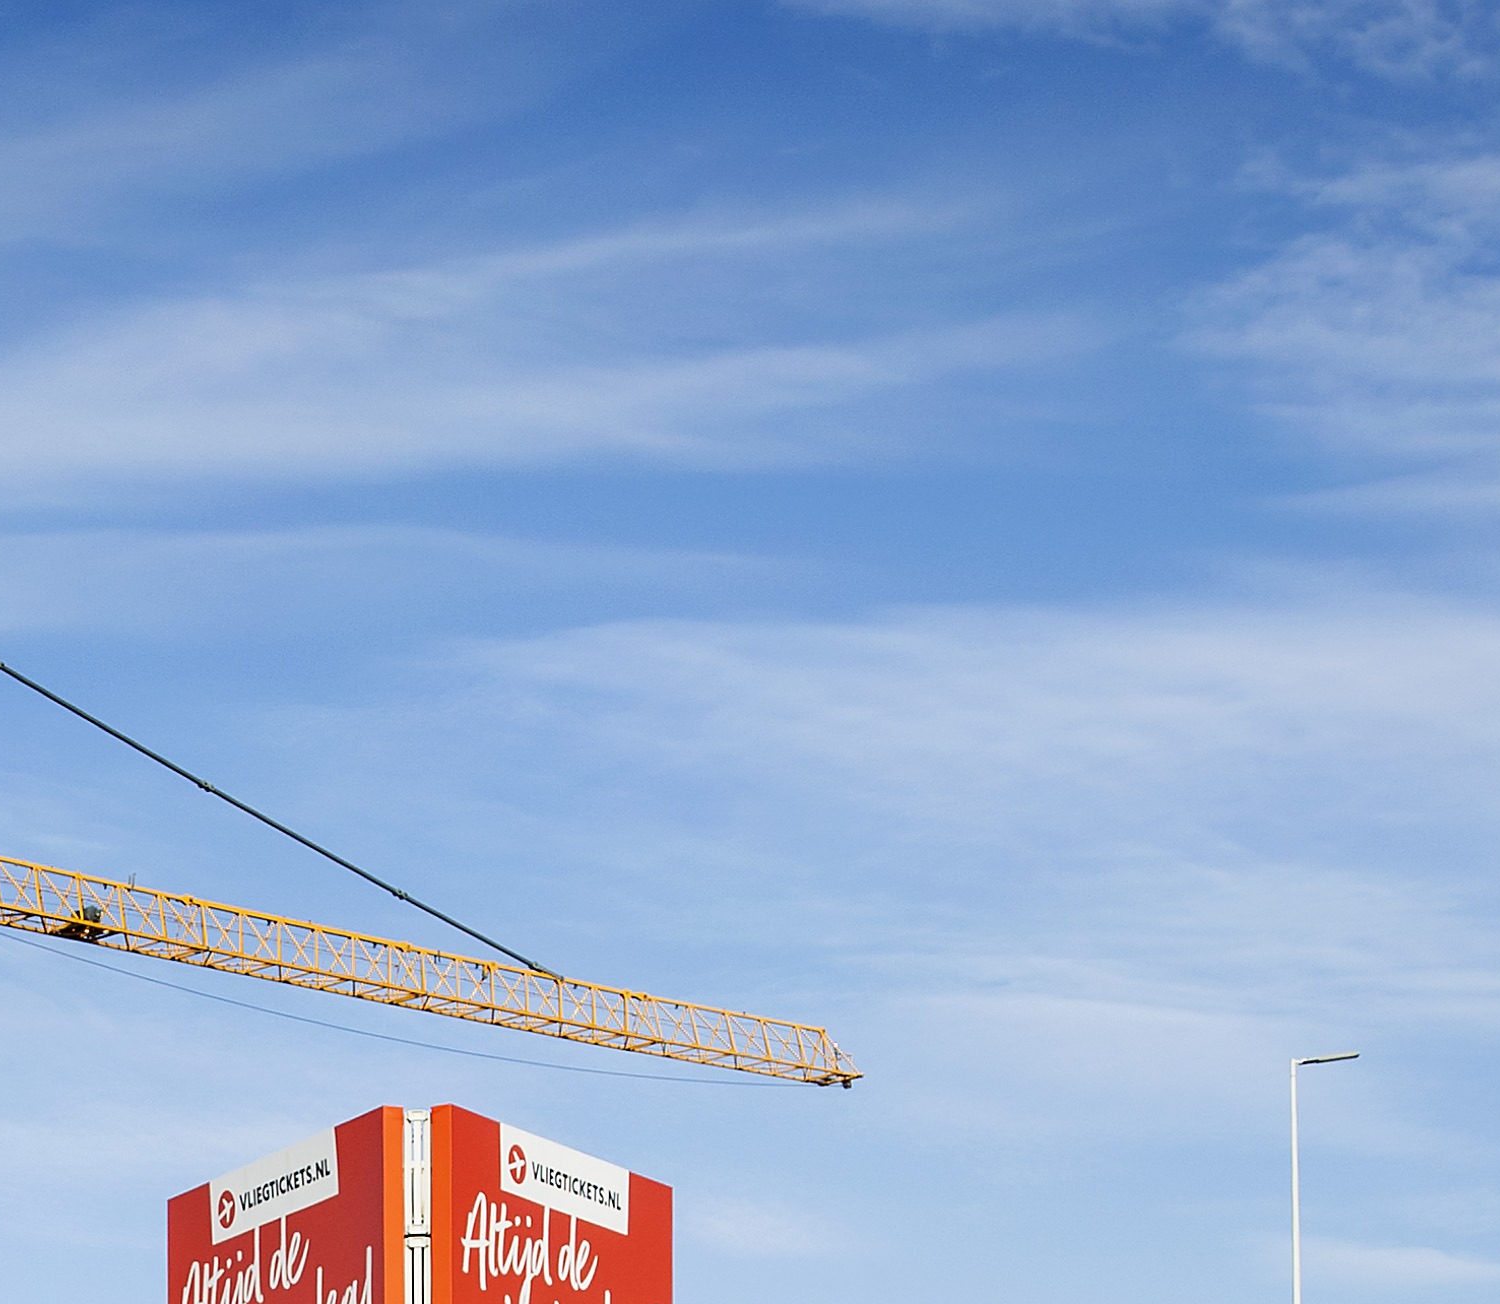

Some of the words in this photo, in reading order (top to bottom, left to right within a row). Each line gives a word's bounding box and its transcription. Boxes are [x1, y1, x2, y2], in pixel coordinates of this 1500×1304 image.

[219, 1158, 331, 1212] VLIEGTICKETS.NL
[532, 1161, 622, 1212] VLIEGTICKETS.NL
[270, 1217, 309, 1291] de
[556, 1217, 597, 1292] de
